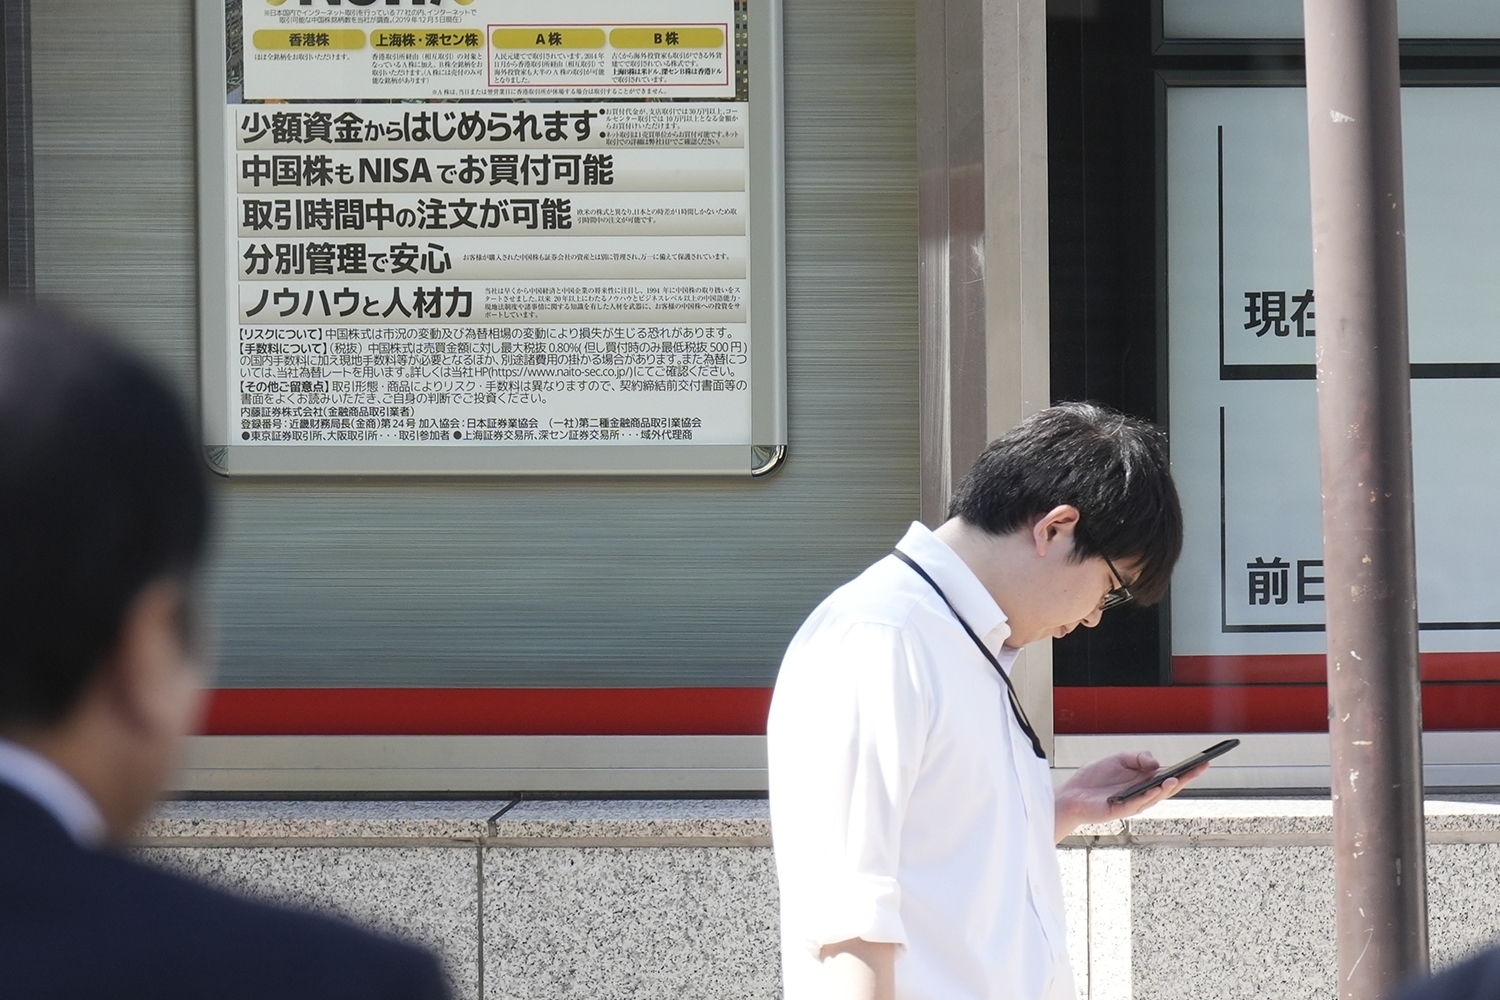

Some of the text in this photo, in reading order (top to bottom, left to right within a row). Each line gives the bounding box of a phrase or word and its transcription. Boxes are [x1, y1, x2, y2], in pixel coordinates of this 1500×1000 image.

[288, 33, 330, 46] 香港株
[375, 33, 479, 47] 上海株・深セン株
[535, 32, 563, 45] A株
[653, 32, 680, 45] B株
[240, 110, 598, 143] 少額資金からはじめられます
[242, 154, 614, 186] 中国株もNISAでお買付可能
[242, 198, 573, 230] 取引時間中の注文が可能
[242, 242, 452, 274] 分別管理で安心
[245, 287, 473, 318] ノウハウと人材力
